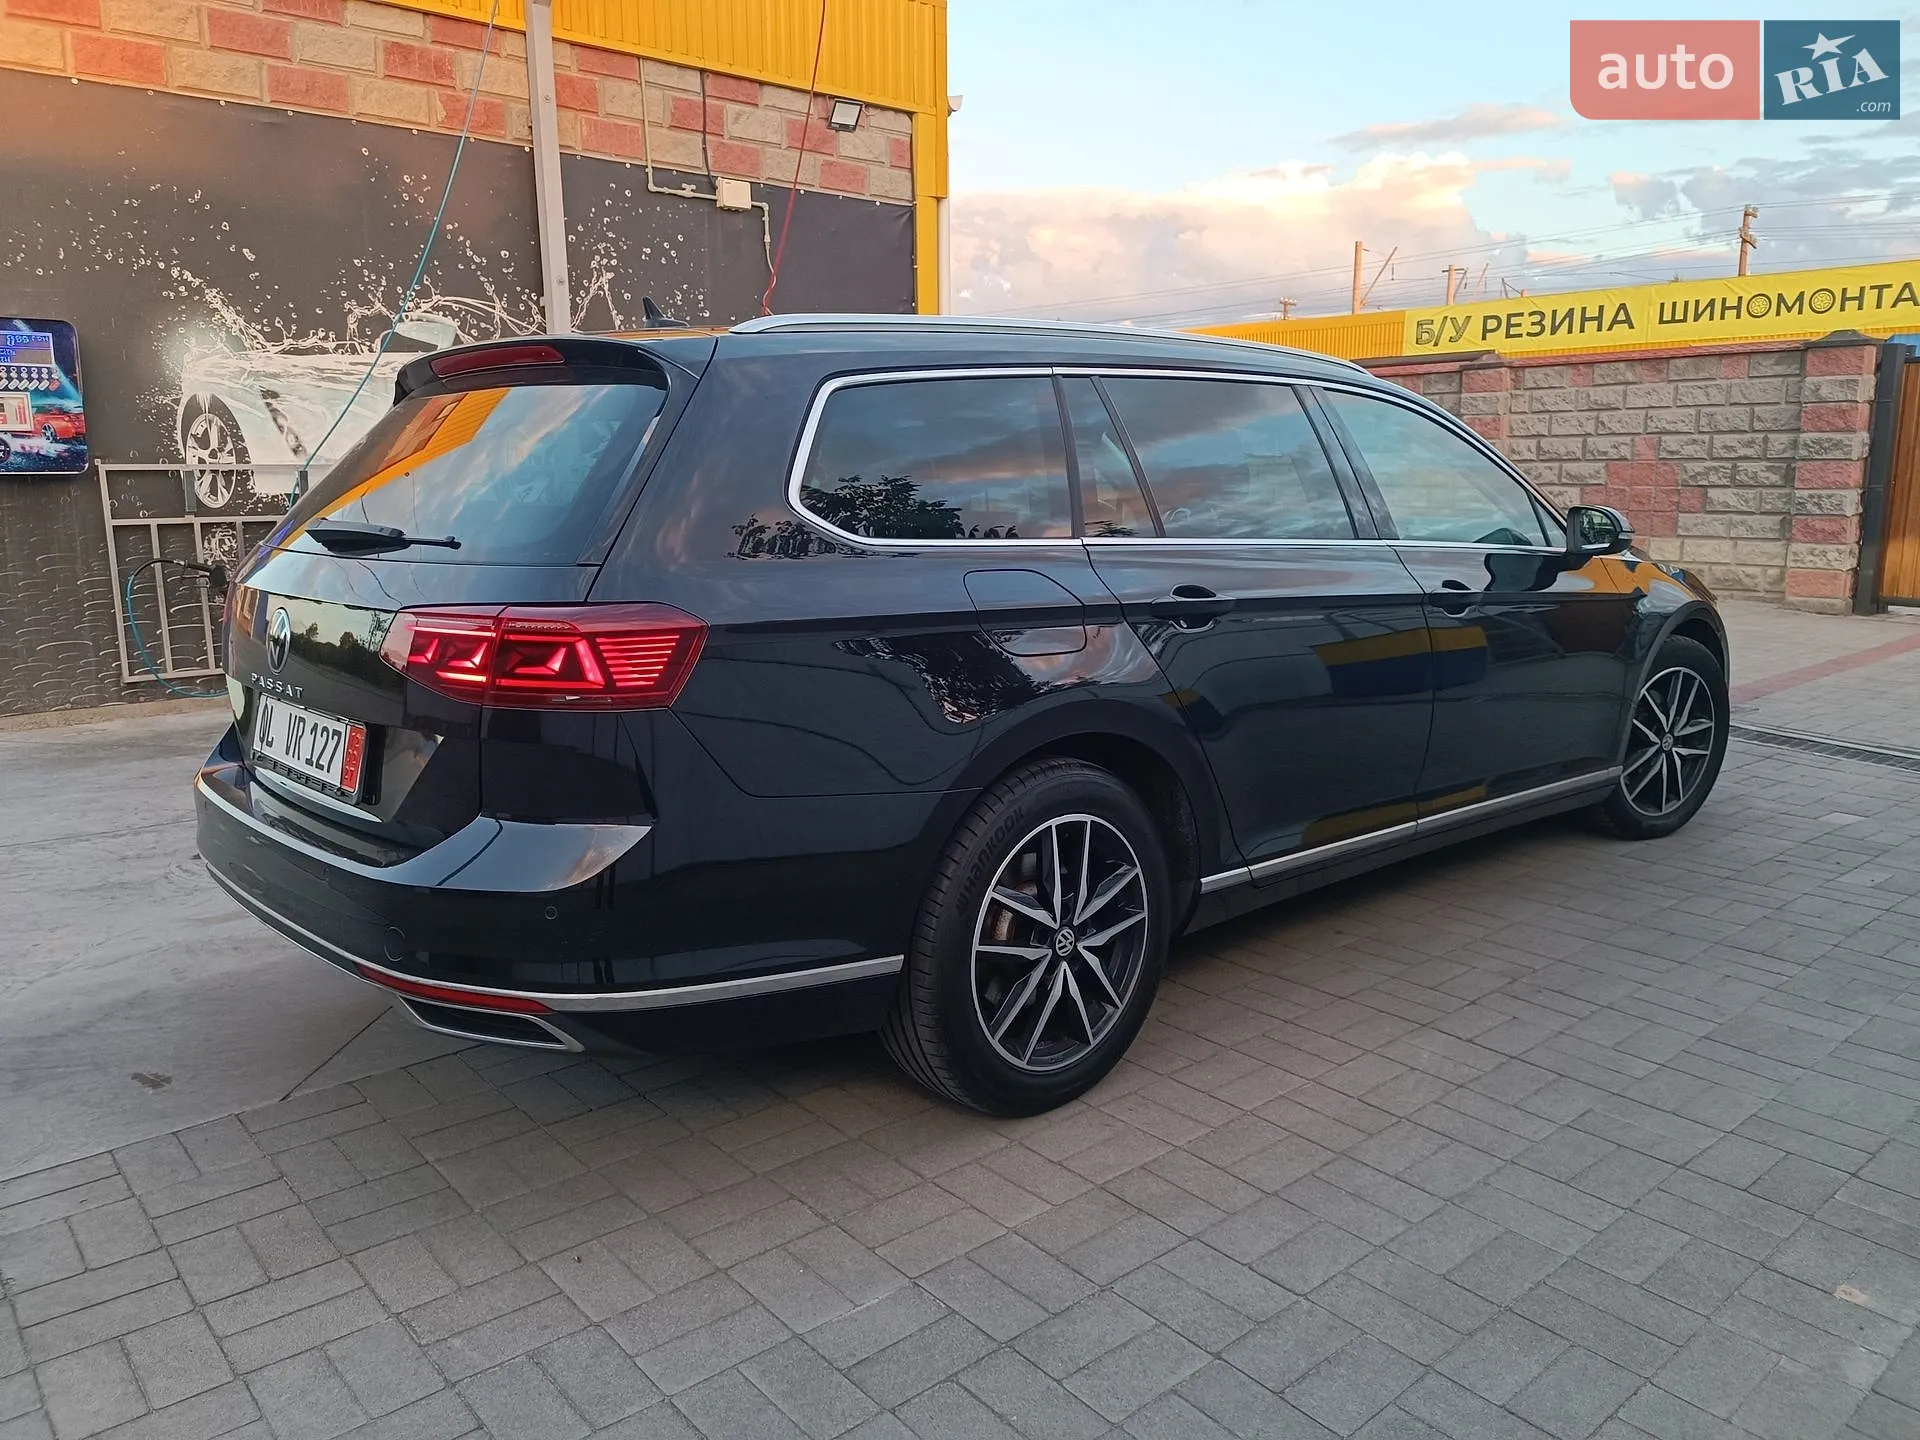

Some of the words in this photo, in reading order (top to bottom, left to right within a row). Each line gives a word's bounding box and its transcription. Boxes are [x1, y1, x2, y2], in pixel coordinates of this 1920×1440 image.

[1414, 315, 1472, 346] Б/У
[1481, 302, 1635, 341] РЕЗИНА
[1658, 281, 1920, 325] ШИНОМОНТА
[251, 672, 303, 698] PASSAT
[285, 712, 306, 760] VR
[304, 722, 342, 774] 127
